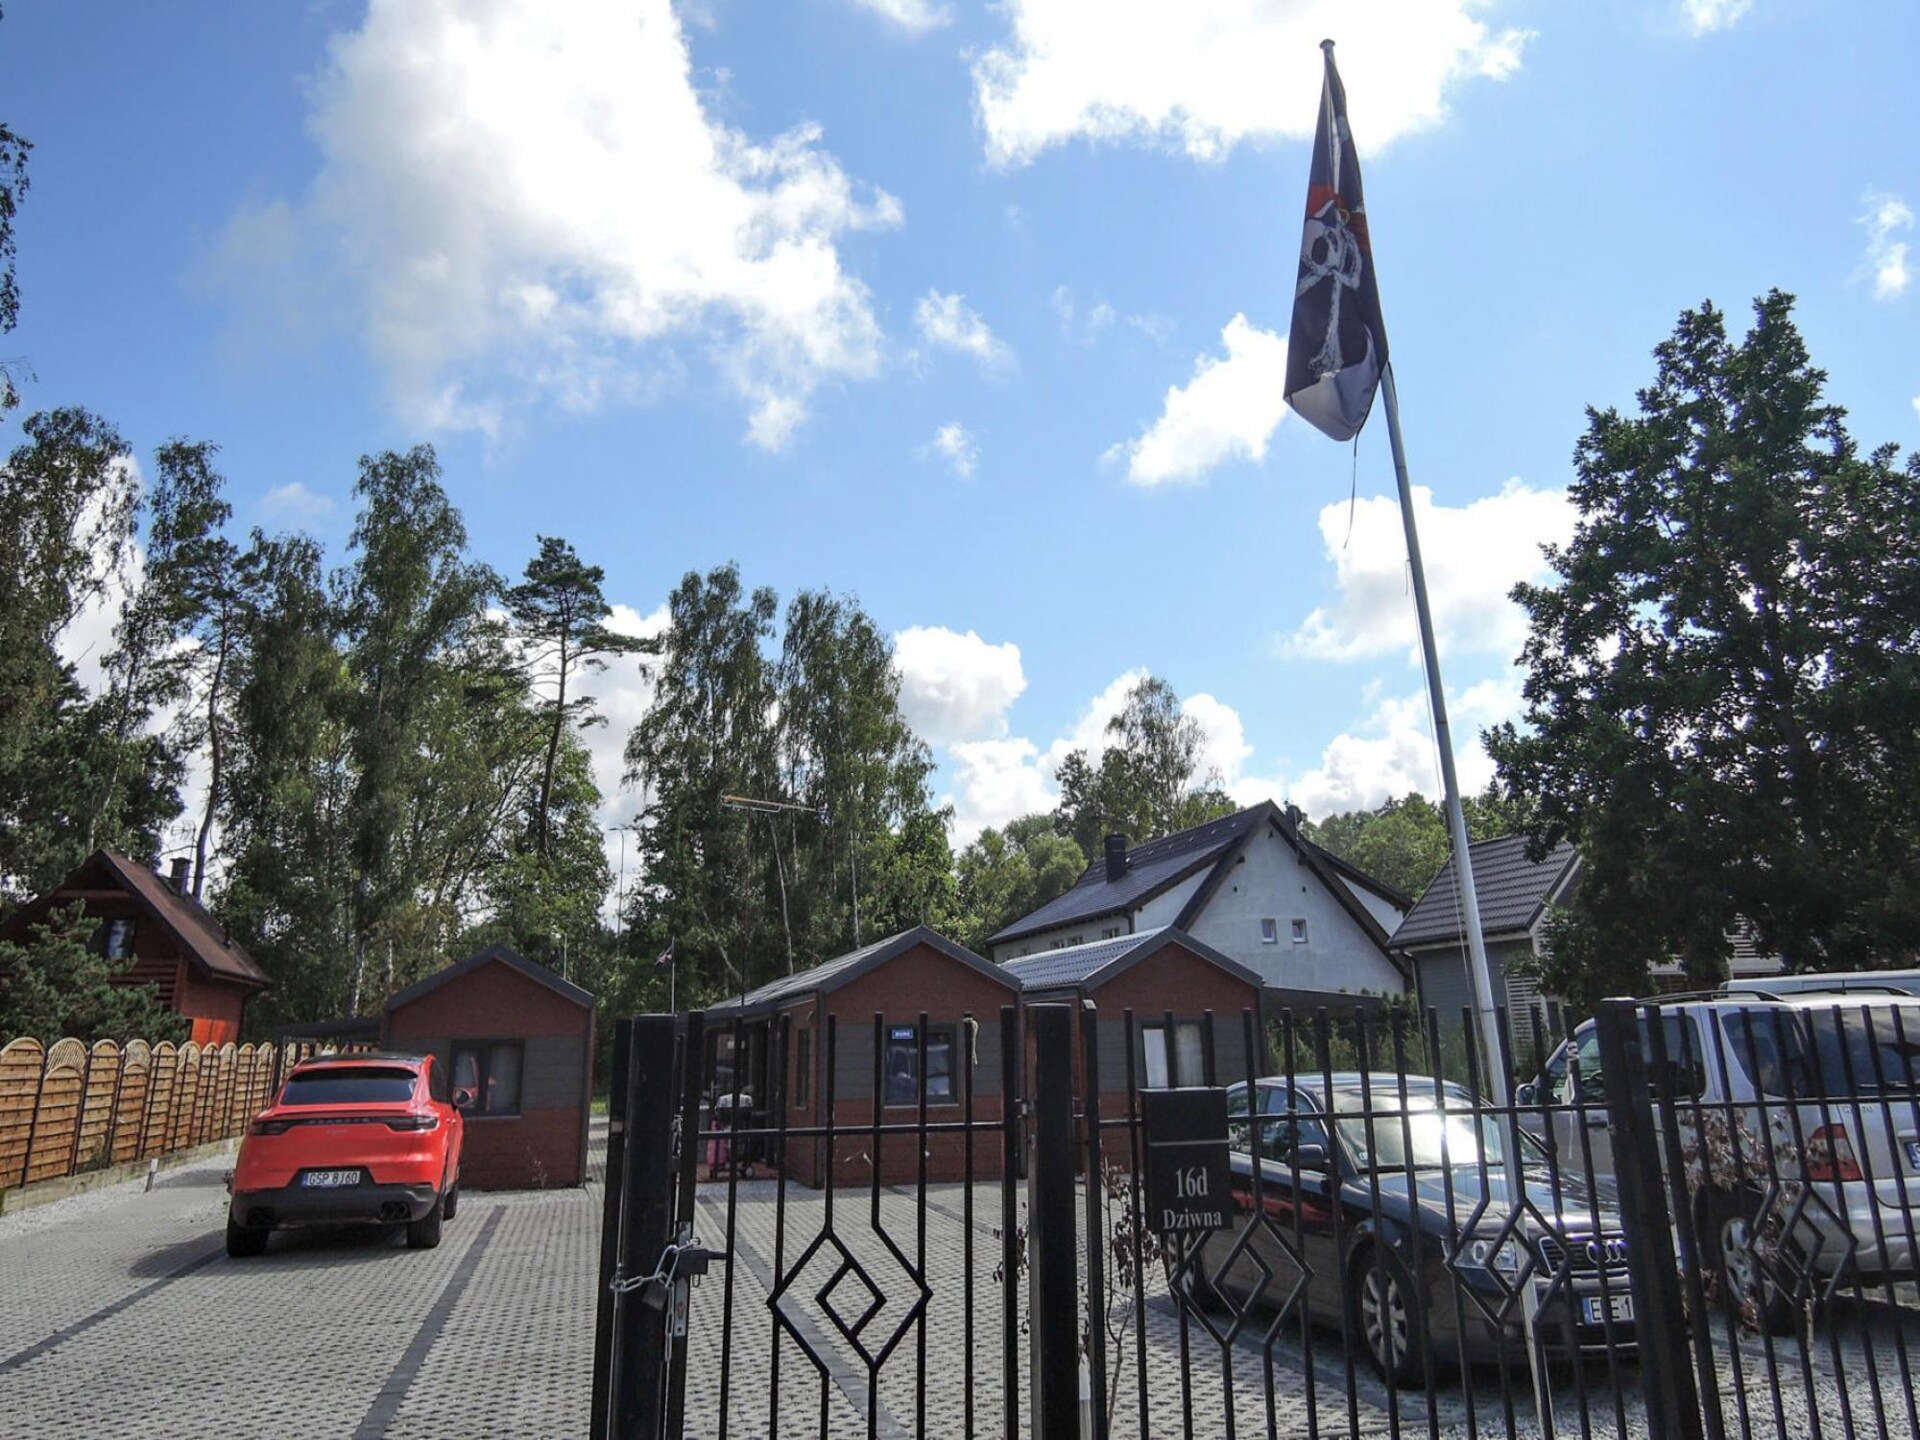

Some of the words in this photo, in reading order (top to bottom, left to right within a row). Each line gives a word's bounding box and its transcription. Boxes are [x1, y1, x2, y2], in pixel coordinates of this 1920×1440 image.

[309, 1173, 329, 1185] GSP
[1176, 1166, 1209, 1198] 16d
[1162, 1208, 1222, 1230] Dziwna
